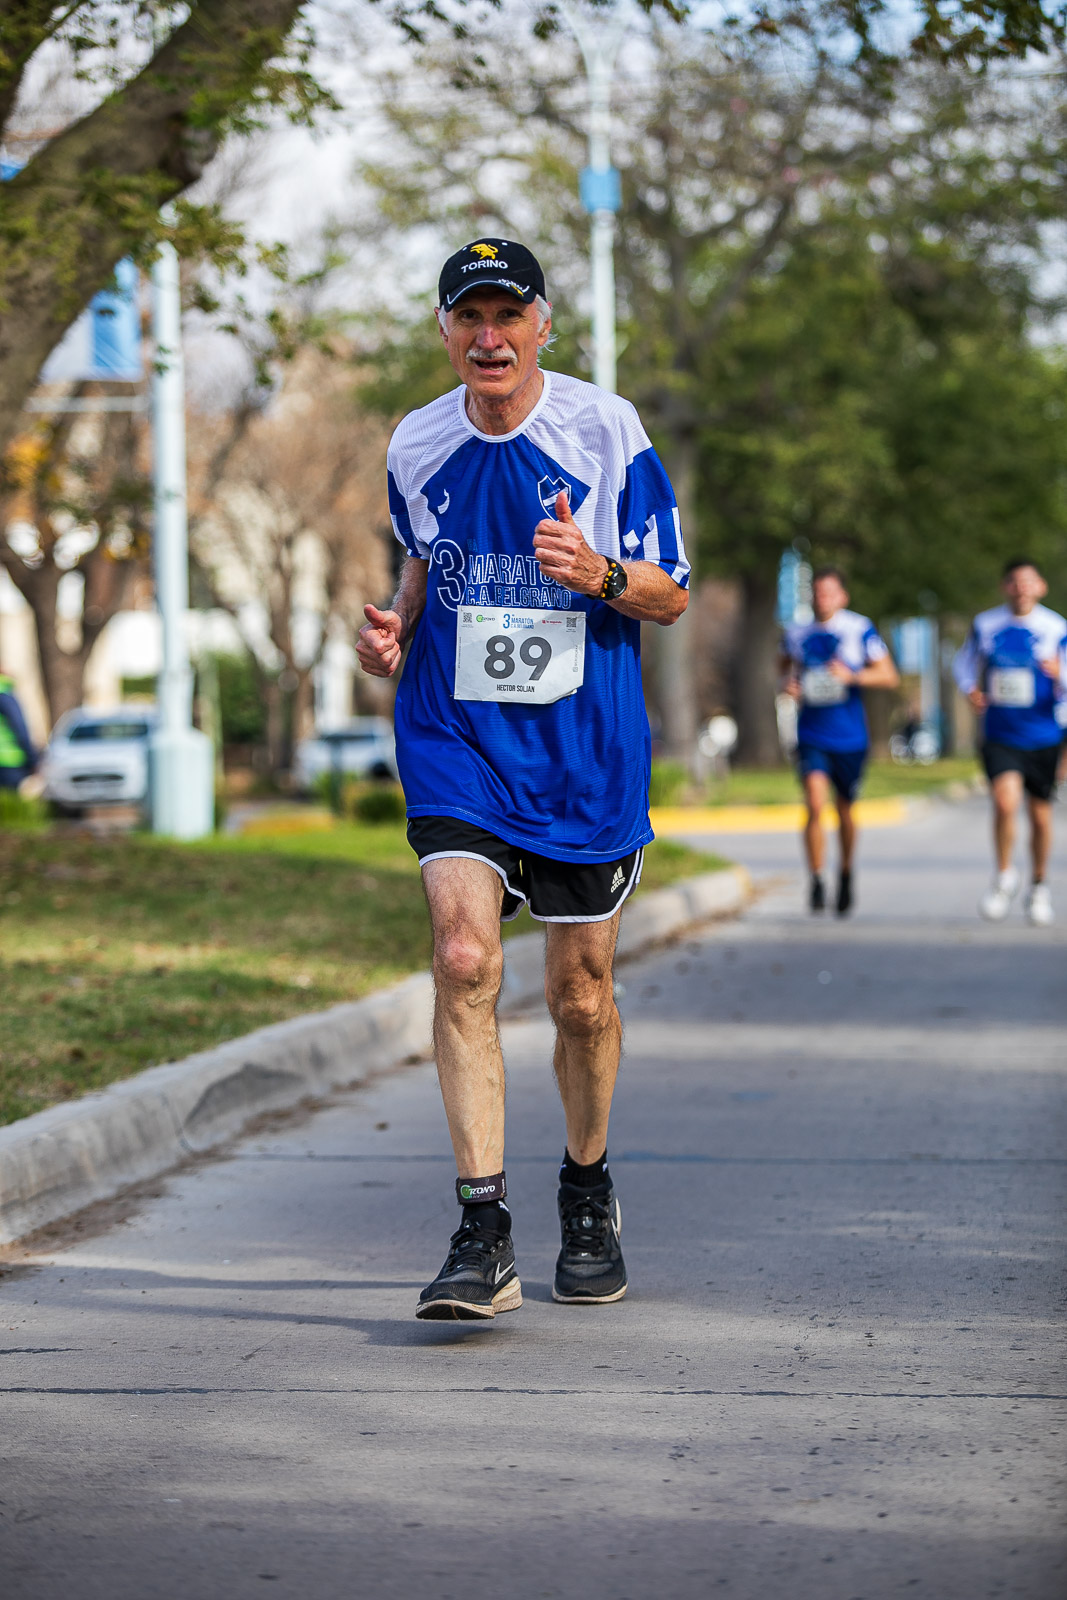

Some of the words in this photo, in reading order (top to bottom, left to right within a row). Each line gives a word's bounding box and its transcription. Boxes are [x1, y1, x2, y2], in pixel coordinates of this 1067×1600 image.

[460, 259, 509, 274] TORINO
[432, 538, 468, 612] 3
[467, 553, 562, 587] MARAT
[502, 613, 511, 629] 3
[484, 634, 553, 682] 89
[496, 684, 516, 693] HECTOR
